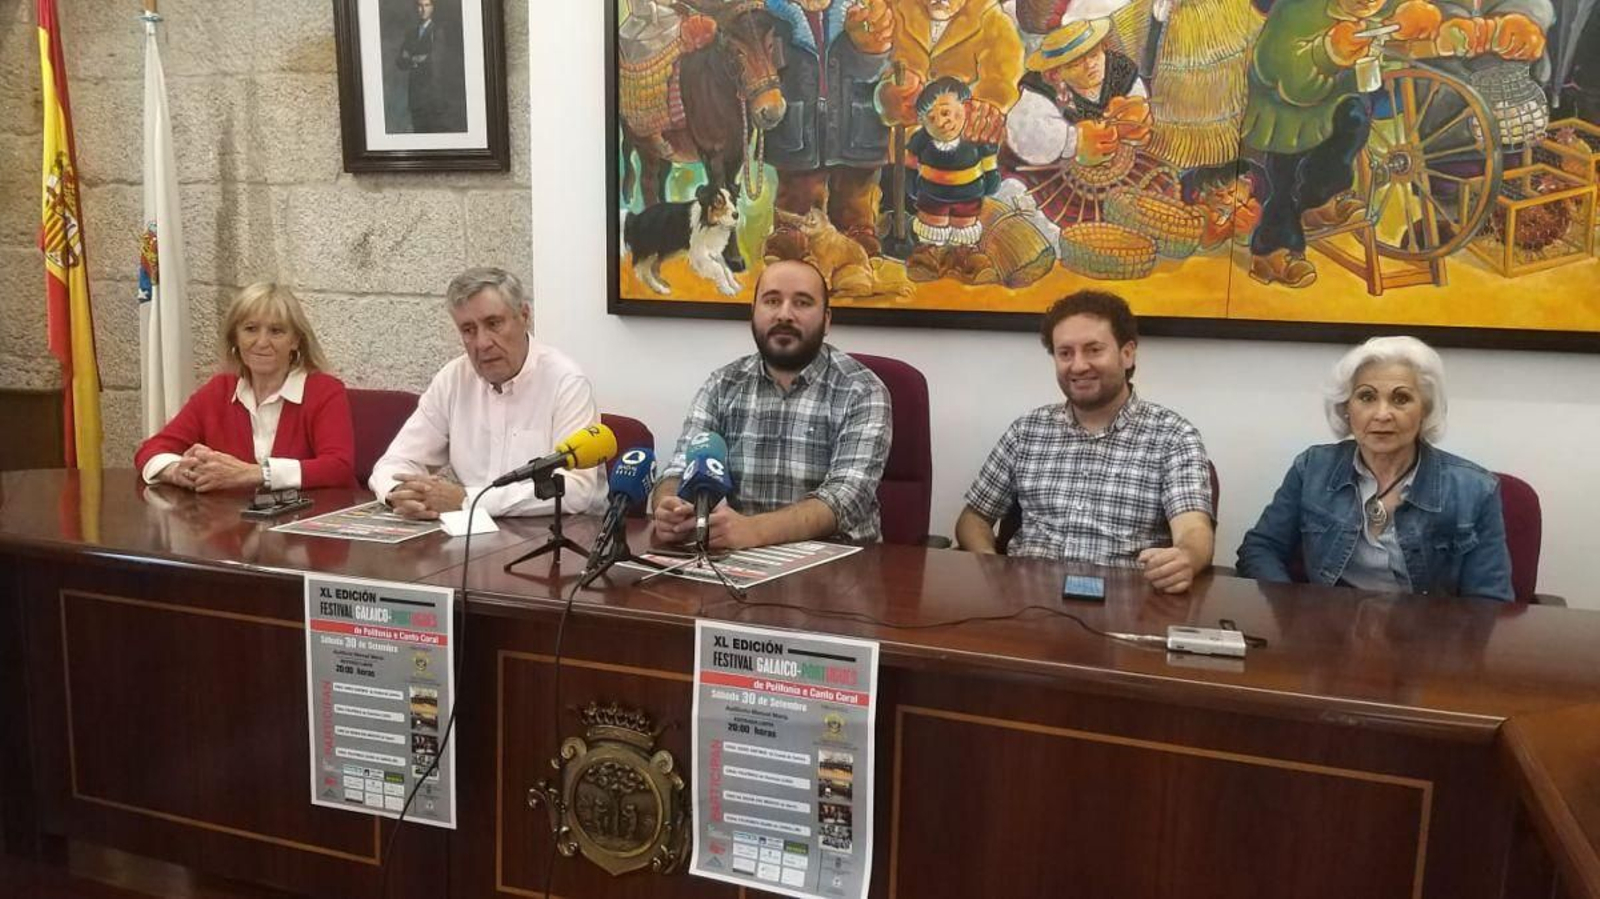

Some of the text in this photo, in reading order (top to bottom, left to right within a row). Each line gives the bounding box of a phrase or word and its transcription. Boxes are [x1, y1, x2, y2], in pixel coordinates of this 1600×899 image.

[319, 587, 377, 604] XL EDICIÓN
[319, 601, 353, 619] FESTIVAL
[344, 636, 357, 649] 30
[714, 635, 783, 655] XL EDICIÓN
[713, 651, 753, 671] FESTIVAL
[742, 691, 756, 705] 30
[753, 679, 765, 690] de
[810, 687, 834, 701] Canto
[836, 691, 858, 704] Coral
[727, 722, 777, 738] 20:00 horas
